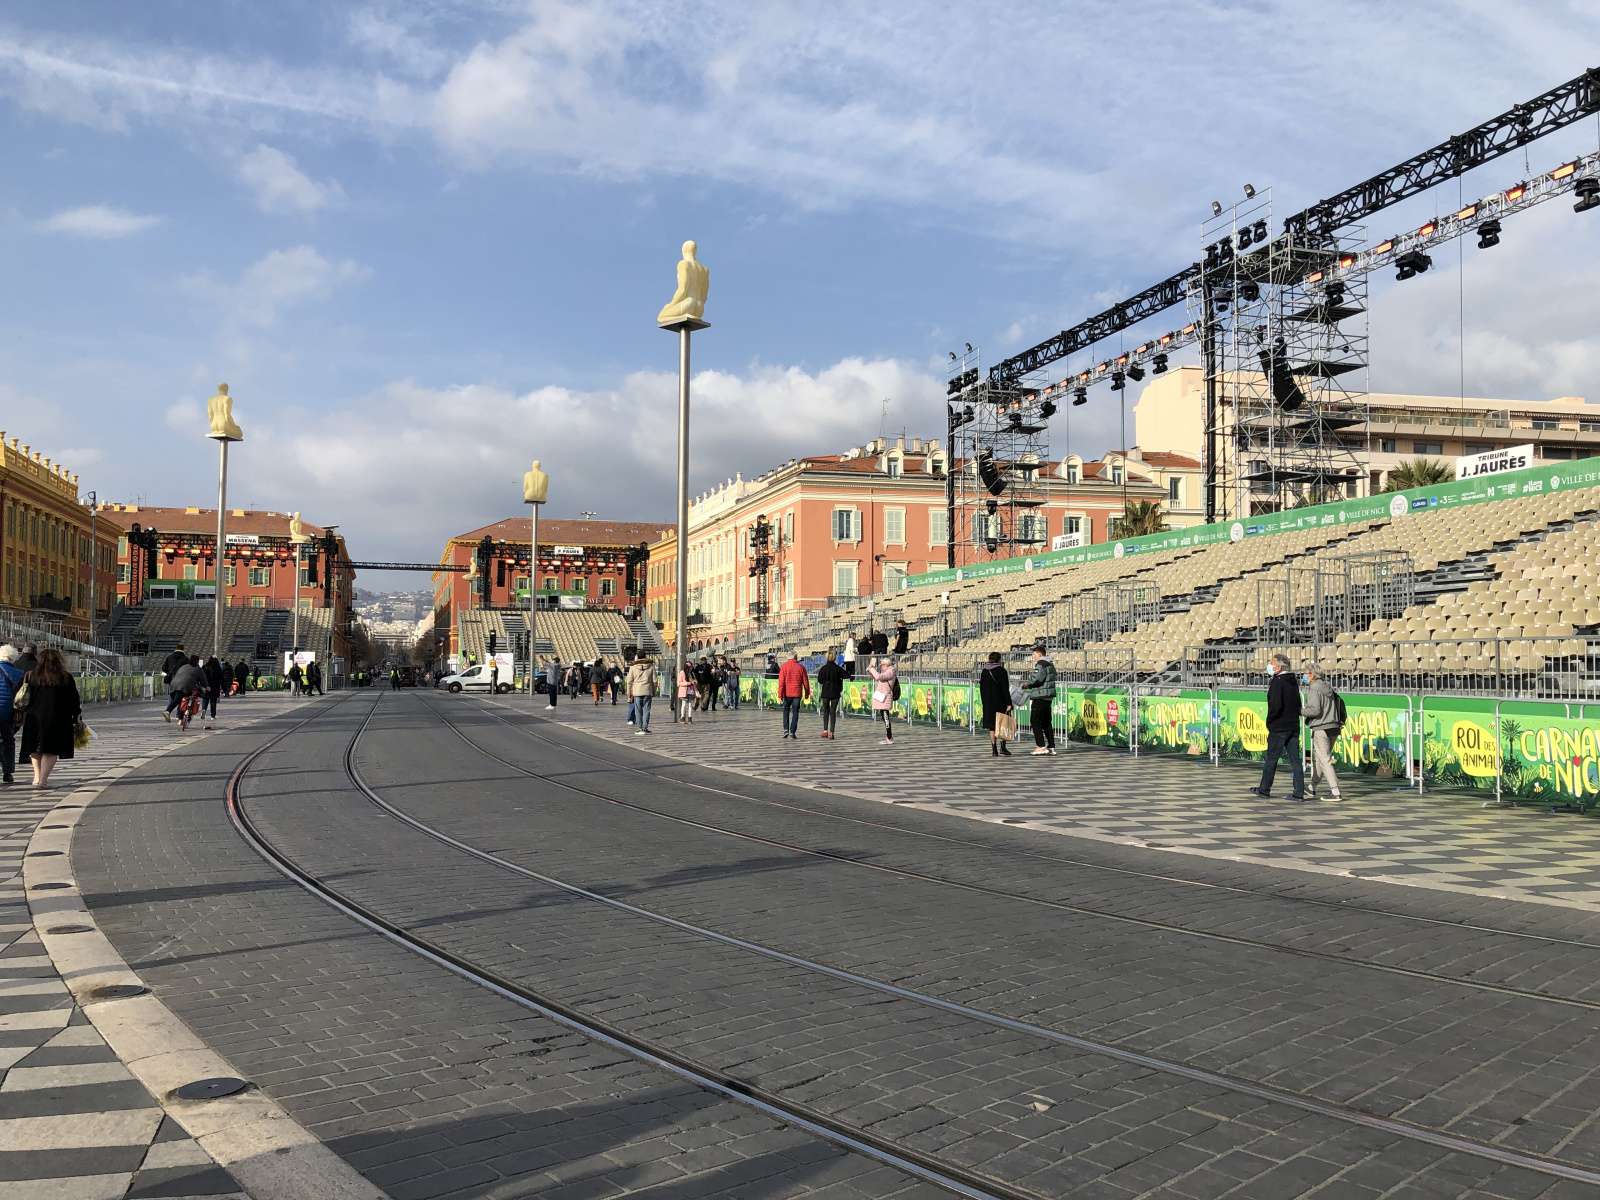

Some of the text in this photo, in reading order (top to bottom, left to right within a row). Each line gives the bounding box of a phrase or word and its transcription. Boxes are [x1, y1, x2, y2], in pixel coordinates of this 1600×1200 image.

[1473, 455, 1526, 475] JAURÈS
[1478, 451, 1509, 462] TRIBUNE
[1561, 475, 1583, 485] VILLE
[1585, 473, 1596, 481] DE
[1346, 507, 1385, 519] VILLE DE NICE
[1084, 704, 1095, 718] ROI
[1148, 701, 1201, 726] CARNAVAL
[1239, 712, 1254, 730] ROI
[1156, 720, 1190, 748] DE NICE
[1457, 727, 1496, 751] ROI DES
[1343, 734, 1379, 768] NICE
[1540, 756, 1600, 798] DE NIC
